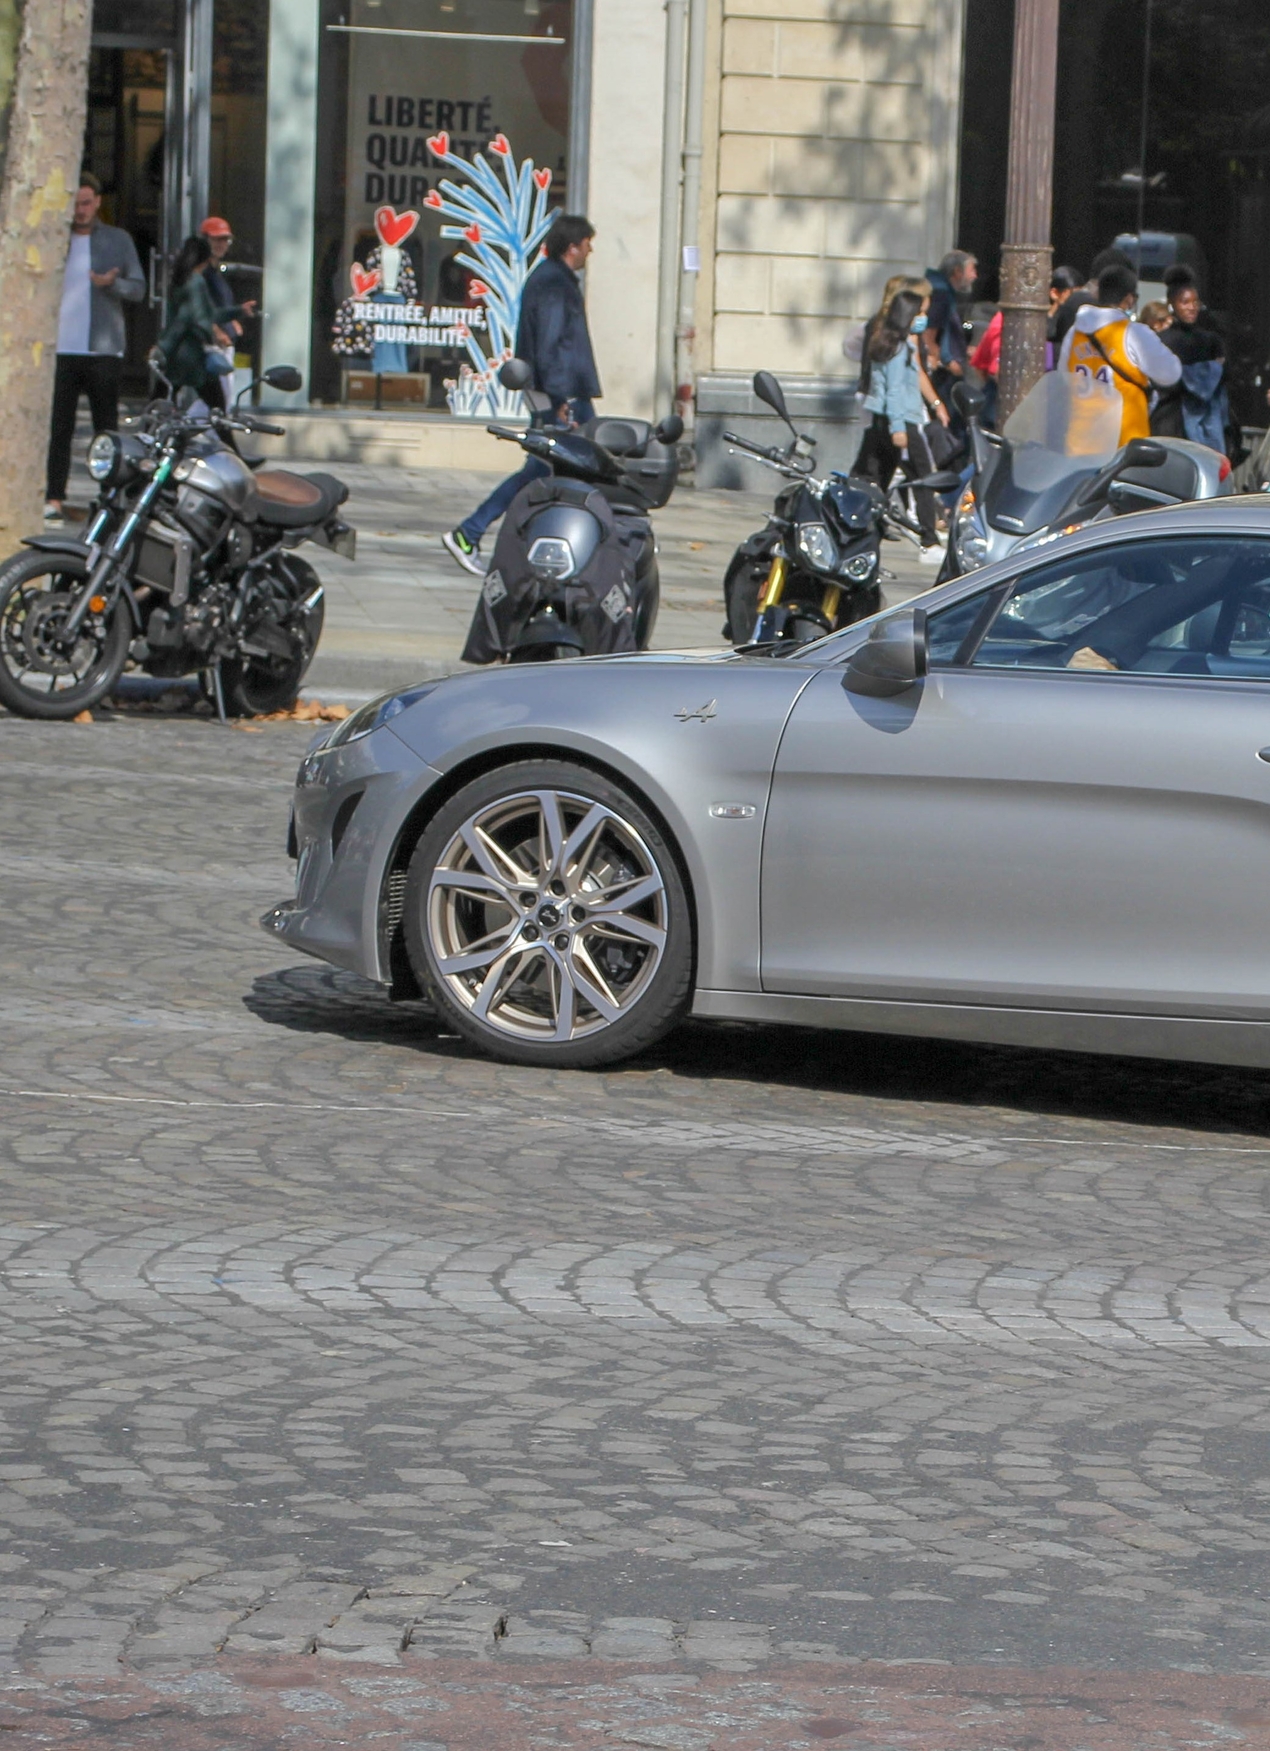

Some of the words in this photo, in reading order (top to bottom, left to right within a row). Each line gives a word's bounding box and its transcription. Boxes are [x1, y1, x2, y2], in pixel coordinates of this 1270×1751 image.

[368, 94, 501, 134] LIBERTÉ,
[352, 298, 428, 326] RENTRÉE,
[429, 305, 487, 330] AMITIÉ,
[1075, 364, 1113, 398] 34
